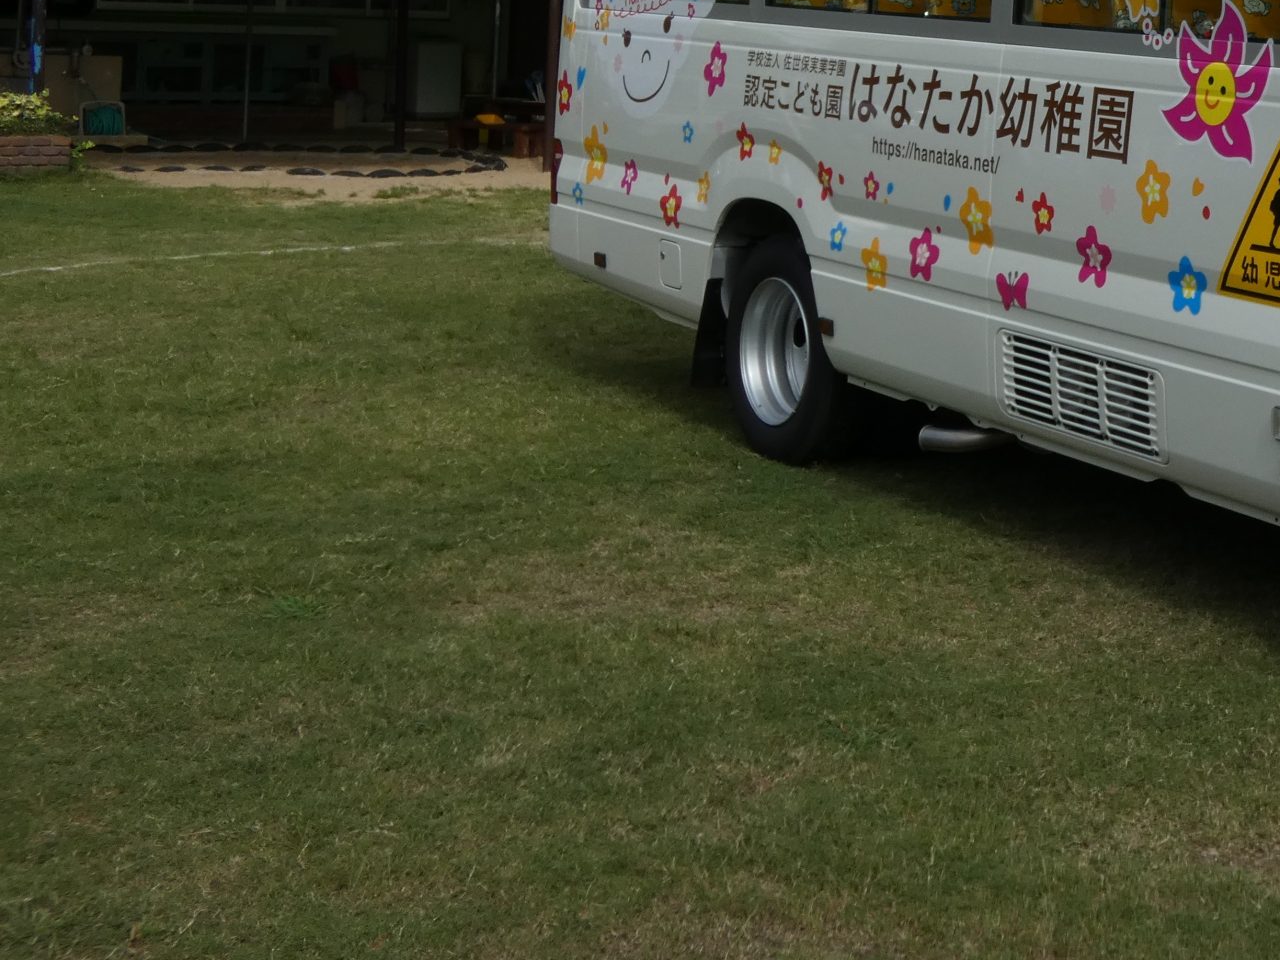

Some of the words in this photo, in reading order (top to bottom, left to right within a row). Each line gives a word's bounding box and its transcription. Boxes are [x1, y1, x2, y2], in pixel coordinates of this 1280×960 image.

[747, 50, 780, 71] 学校法人
[783, 54, 847, 78] 佐世保実業学園
[743, 74, 844, 121] 認定こども園
[849, 62, 1135, 165] はなたか幼稚園
[872, 136, 1001, 175] https://hanataka.net/
